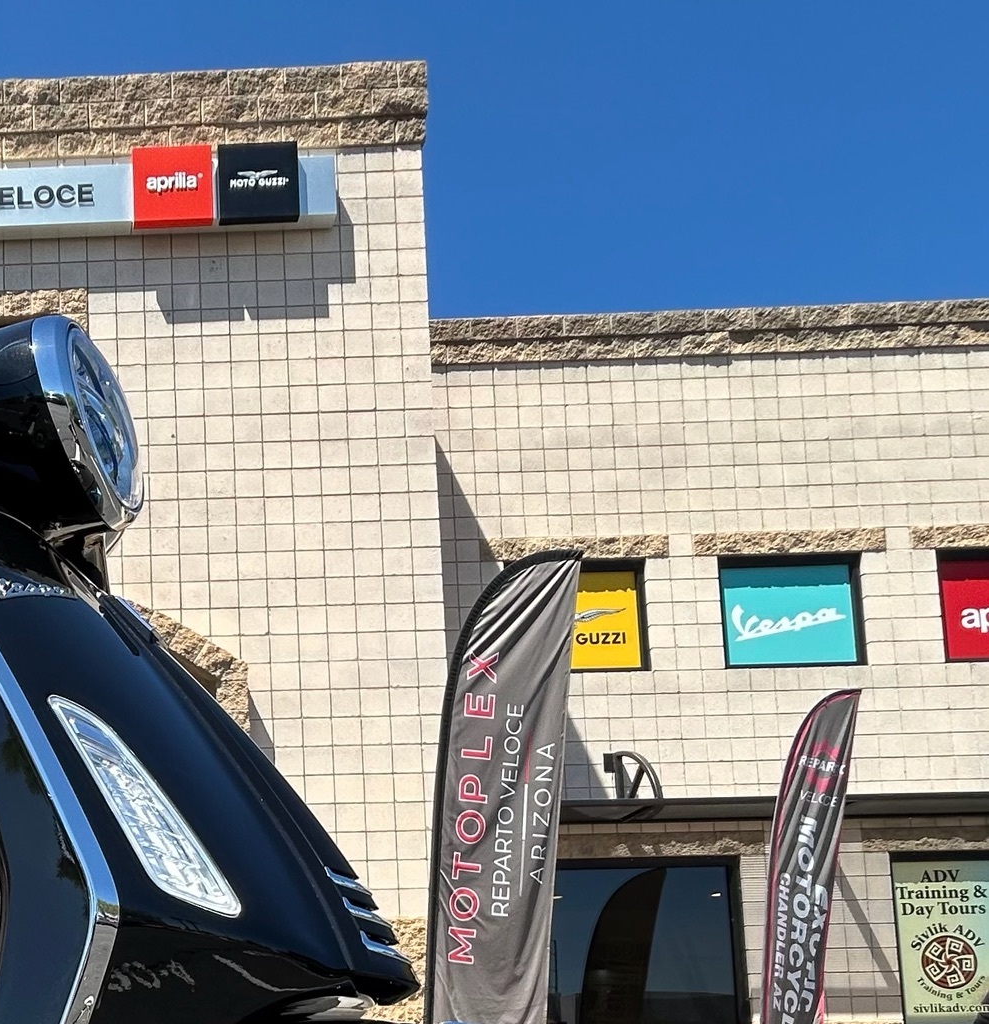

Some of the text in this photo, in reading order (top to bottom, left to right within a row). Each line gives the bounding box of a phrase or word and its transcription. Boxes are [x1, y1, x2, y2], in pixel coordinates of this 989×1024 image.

[146, 171, 198, 194] aprilia
[229, 176, 286, 189] MOTO GUZZI
[731, 604, 847, 642] Vespa
[575, 632, 626, 645] GUZZI
[447, 650, 500, 965] MOTOPLEX
[490, 703, 525, 918] REPARTO VELOCE
[529, 742, 556, 885] ARIZONA
[921, 869, 960, 883] ADV
[896, 884, 988, 902] Training &
[901, 901, 986, 919] Day Tours
[772, 873, 791, 1012] CHANDLER AZ
[910, 922, 986, 951] Sivlik ADV
[916, 976, 953, 1001] Training
[965, 974, 986, 995] Tours
